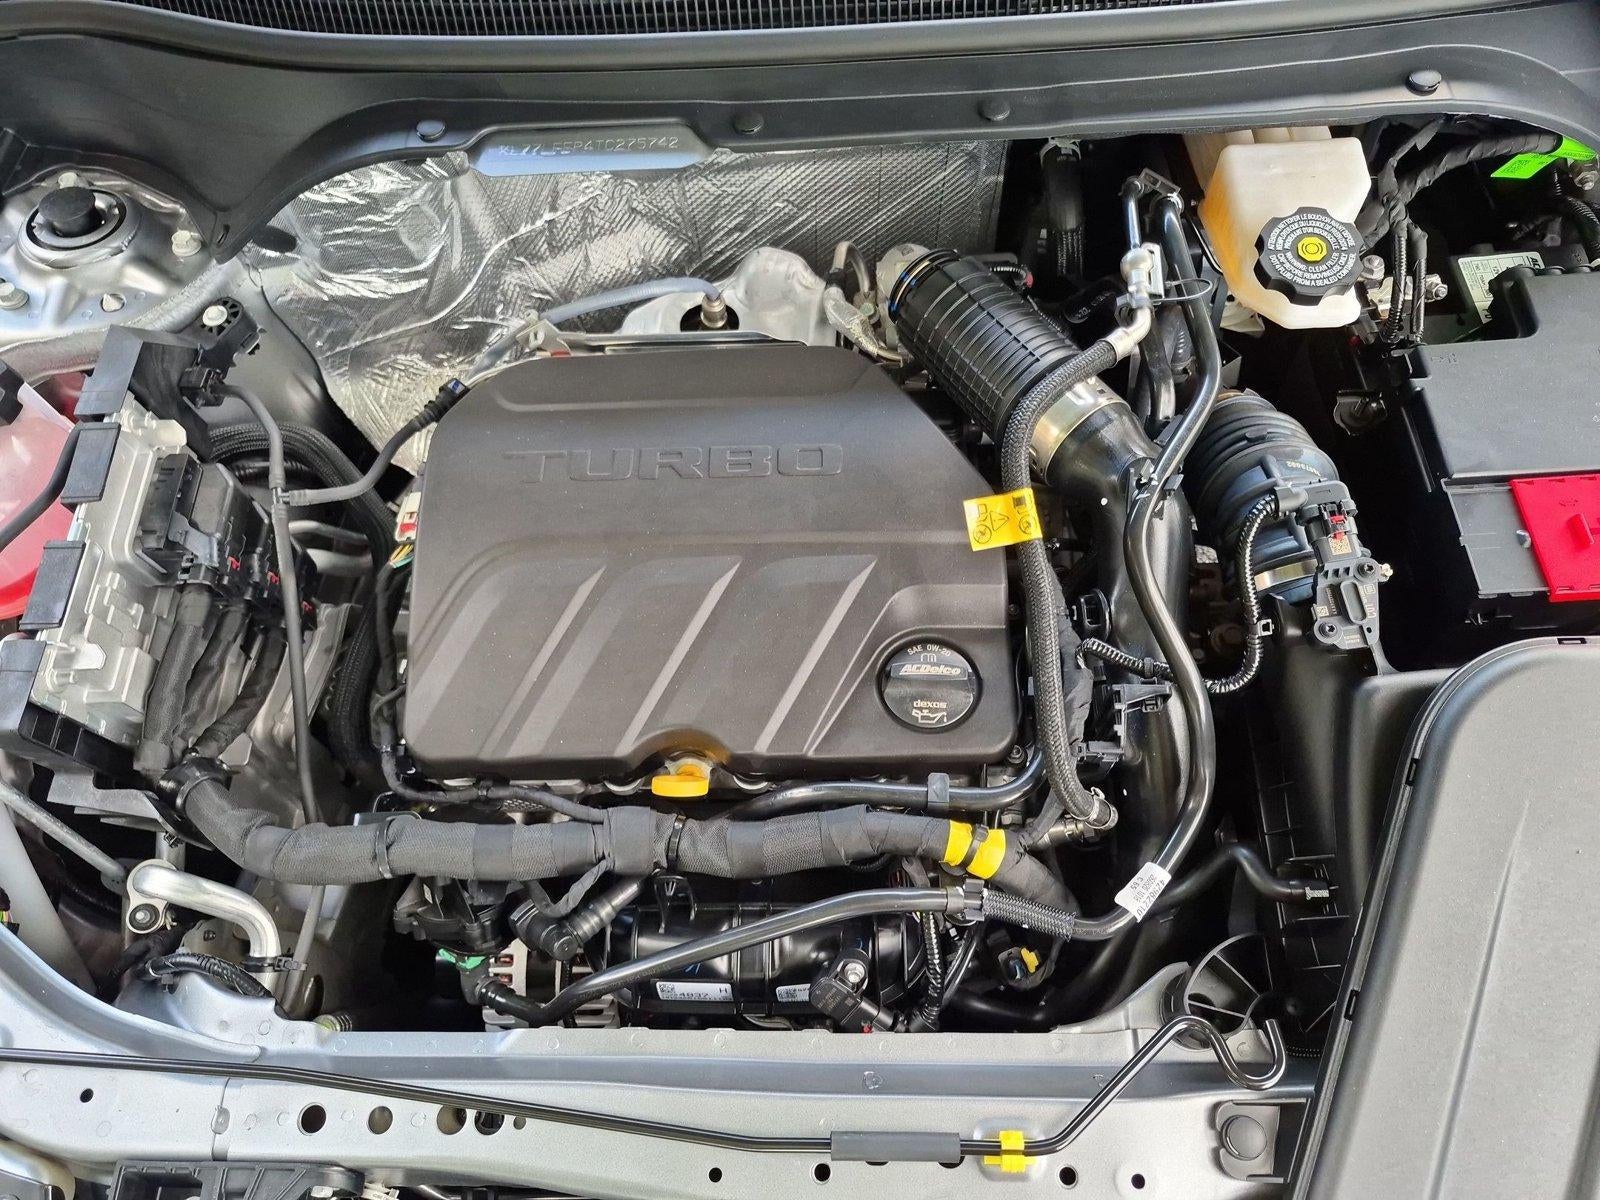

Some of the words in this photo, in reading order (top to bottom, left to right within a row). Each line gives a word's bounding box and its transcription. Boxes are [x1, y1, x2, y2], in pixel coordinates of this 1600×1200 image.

[1308, 264, 1328, 273] CLEAN
[1292, 276, 1311, 286] FROM
[1316, 274, 1339, 287] SEALED
[503, 444, 844, 484] TURBO
[907, 644, 923, 656] SAE
[926, 644, 951, 657] 0W-20
[900, 664, 961, 676] ACDelco
[913, 699, 948, 709] dexos
